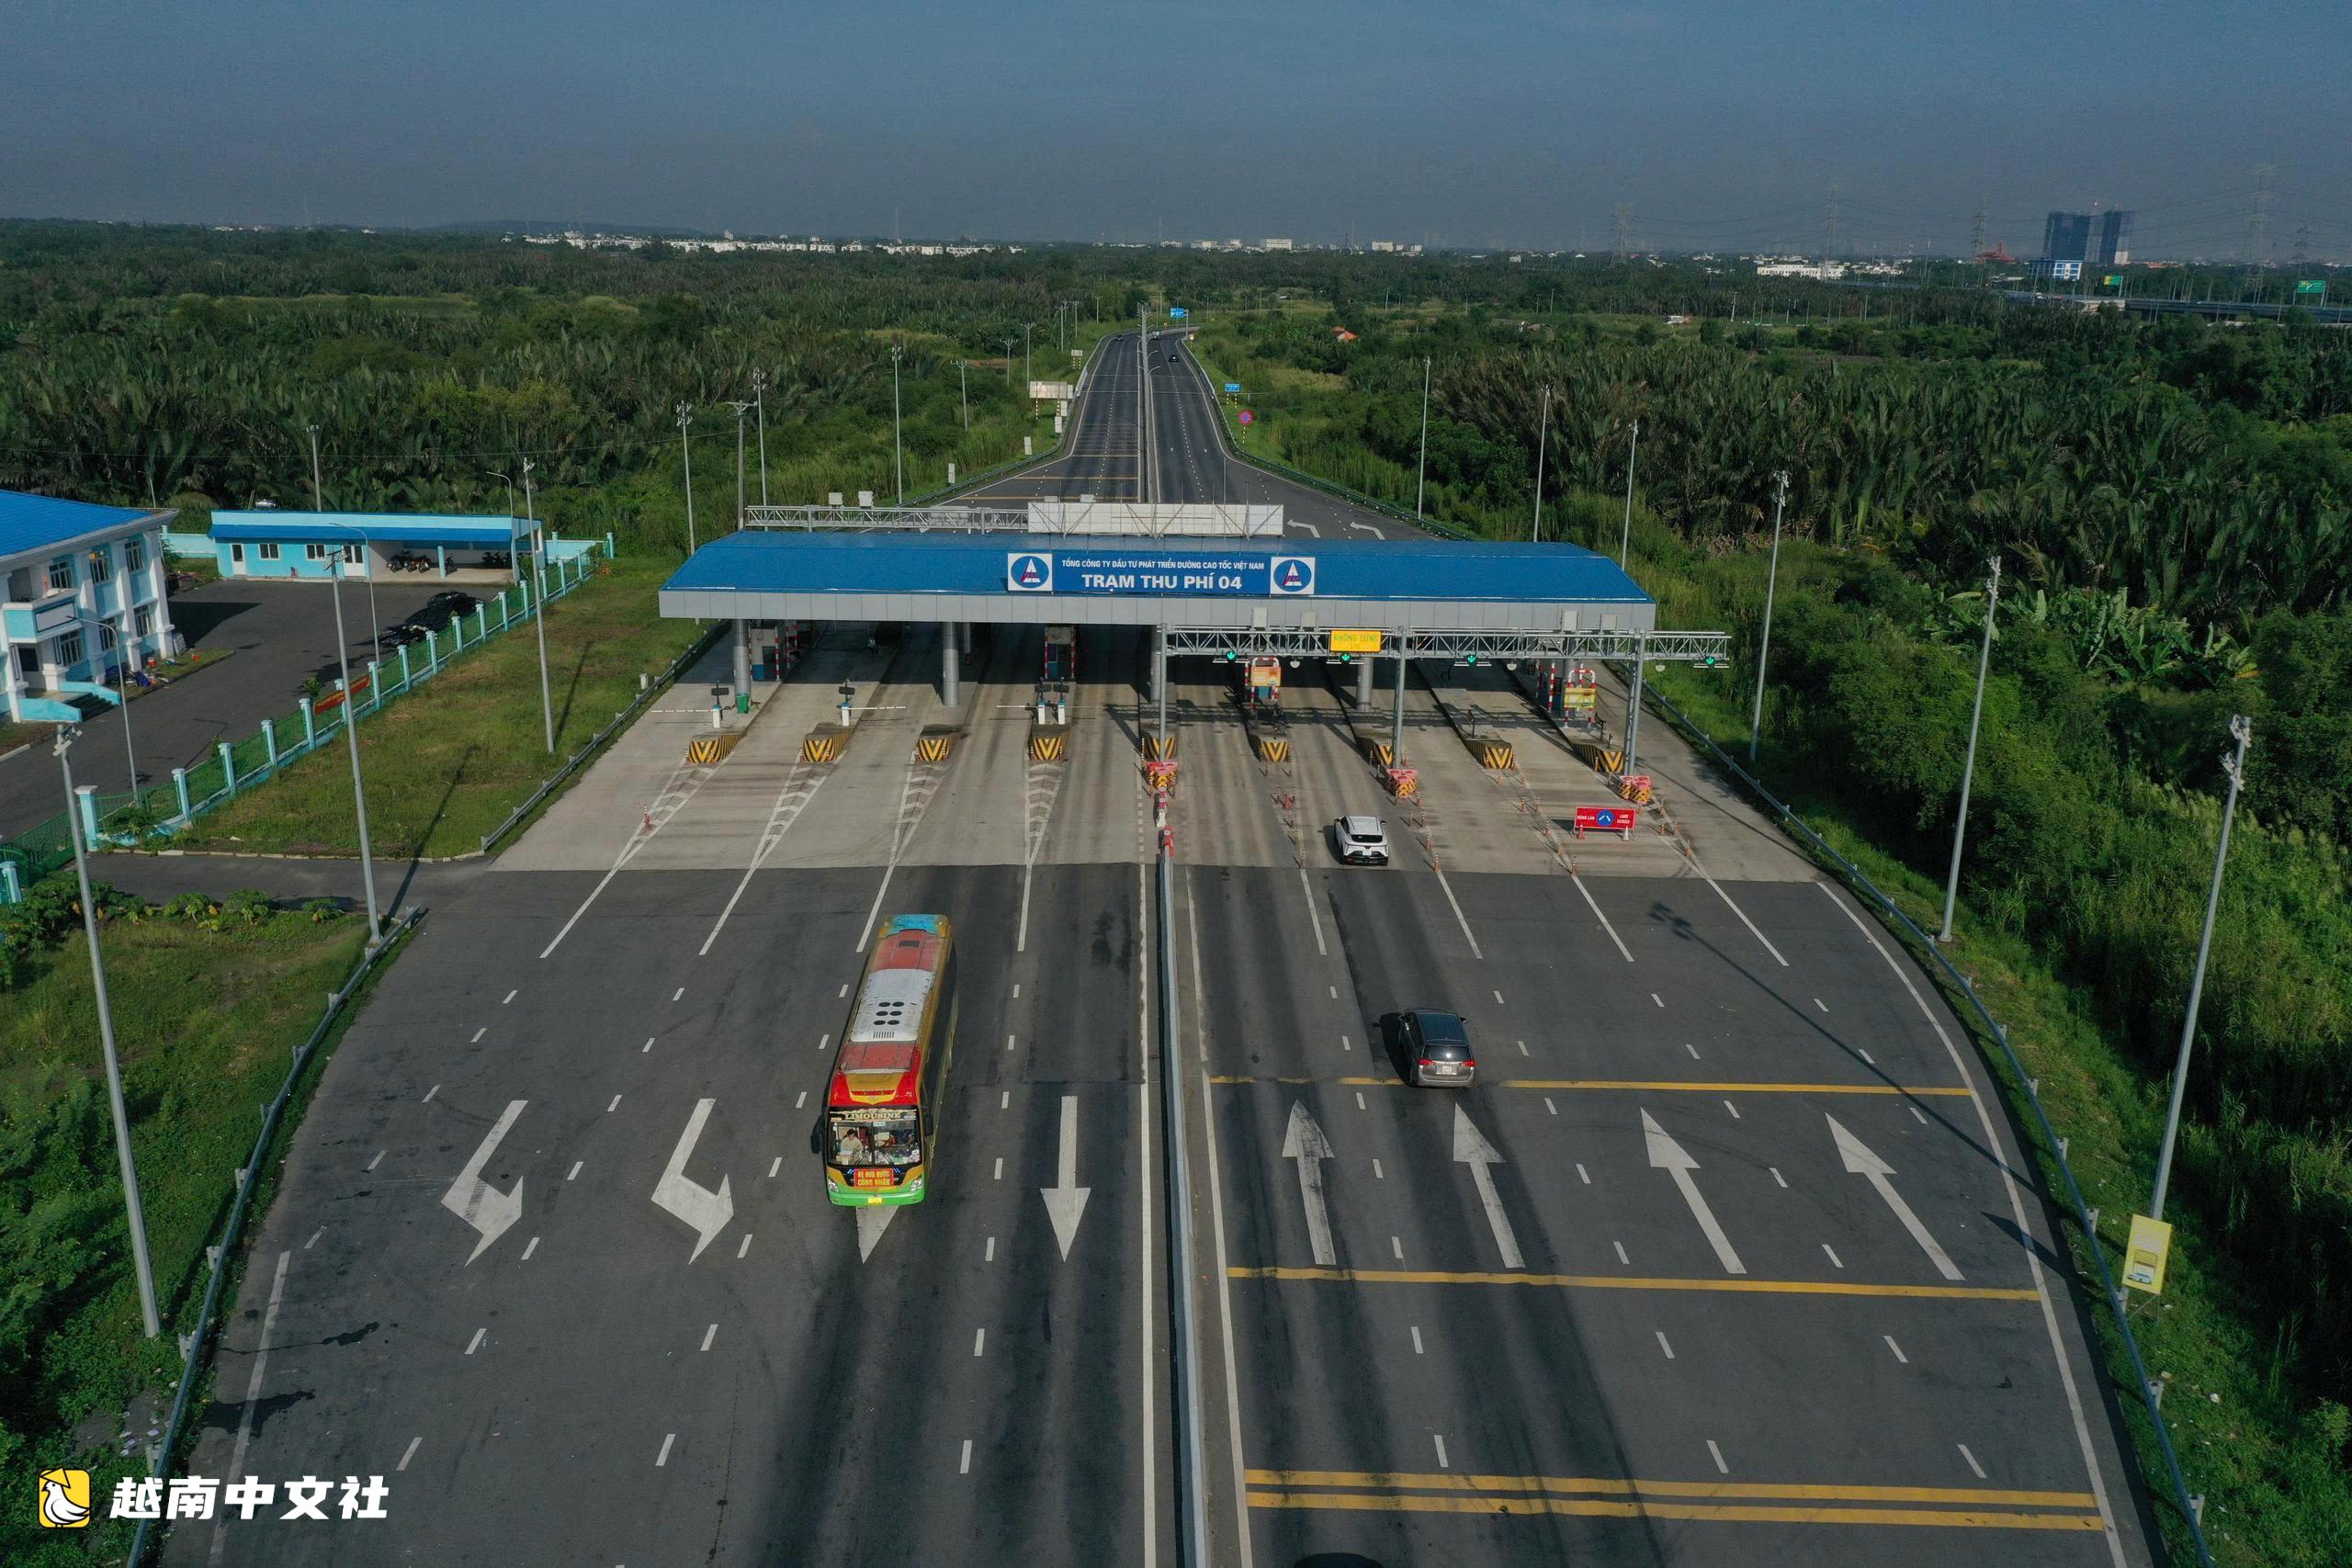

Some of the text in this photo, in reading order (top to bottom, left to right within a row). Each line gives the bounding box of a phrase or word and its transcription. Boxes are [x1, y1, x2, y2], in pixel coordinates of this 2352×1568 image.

[1062, 557, 1080, 568] TỔNG
[1081, 558, 1101, 568] CÔNG
[1128, 559, 1138, 568] TƯ
[1139, 559, 1156, 569] PHÁT
[1158, 558, 1176, 569] TRIỂN
[1218, 559, 1232, 570] TỐC
[1234, 560, 1248, 570] VIỆT
[1081, 572, 1242, 592] TRẠM THU PHÍ 04
[845, 1112, 900, 1121] LIMOUSINE
